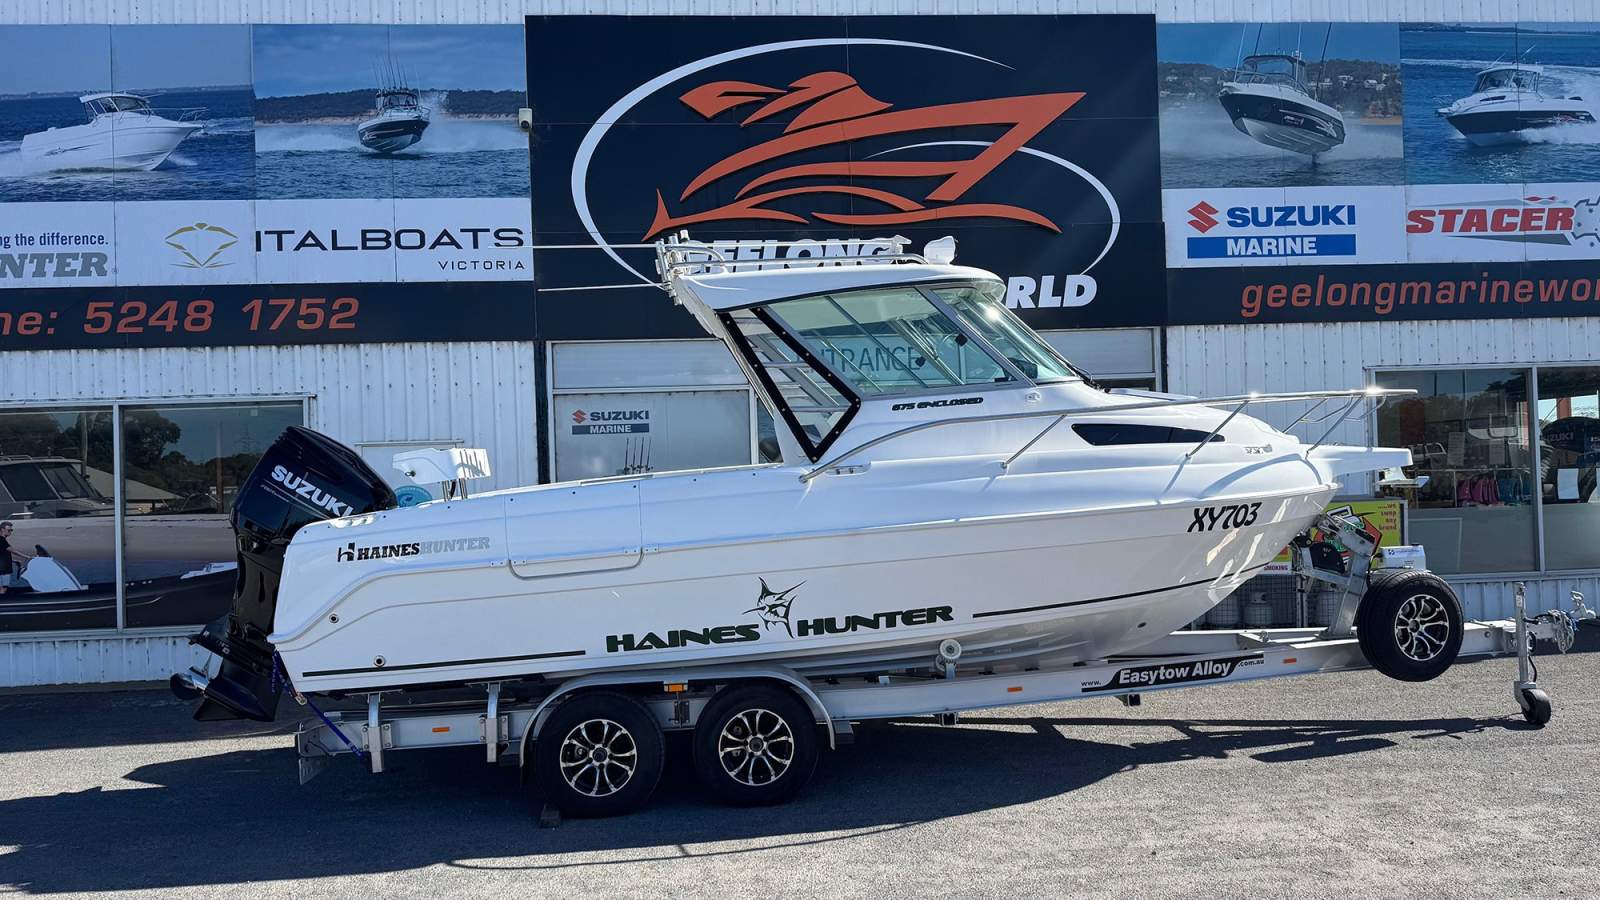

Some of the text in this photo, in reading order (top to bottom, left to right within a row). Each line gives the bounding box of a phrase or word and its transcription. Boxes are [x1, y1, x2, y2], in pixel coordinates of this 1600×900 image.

[1226, 205, 1356, 228] SUZUKI
[1406, 207, 1576, 234] STACER
[14, 233, 35, 246] the
[39, 232, 109, 246] difference.
[255, 228, 524, 251] ITALBOATS
[1226, 237, 1318, 257] MARINE
[437, 260, 525, 271] VICTORIA
[1005, 274, 1098, 309] RLD
[83, 299, 215, 333] 5248
[241, 297, 359, 331] 1752
[590, 410, 650, 421] SUZUKI
[590, 424, 632, 434] MARINE
[271, 464, 354, 517] SUZUKI
[1187, 502, 1263, 532] XY703
[606, 605, 954, 652] HAINES HUNTER
[1080, 658, 1265, 688] www. Easytow Alloy .com.au
